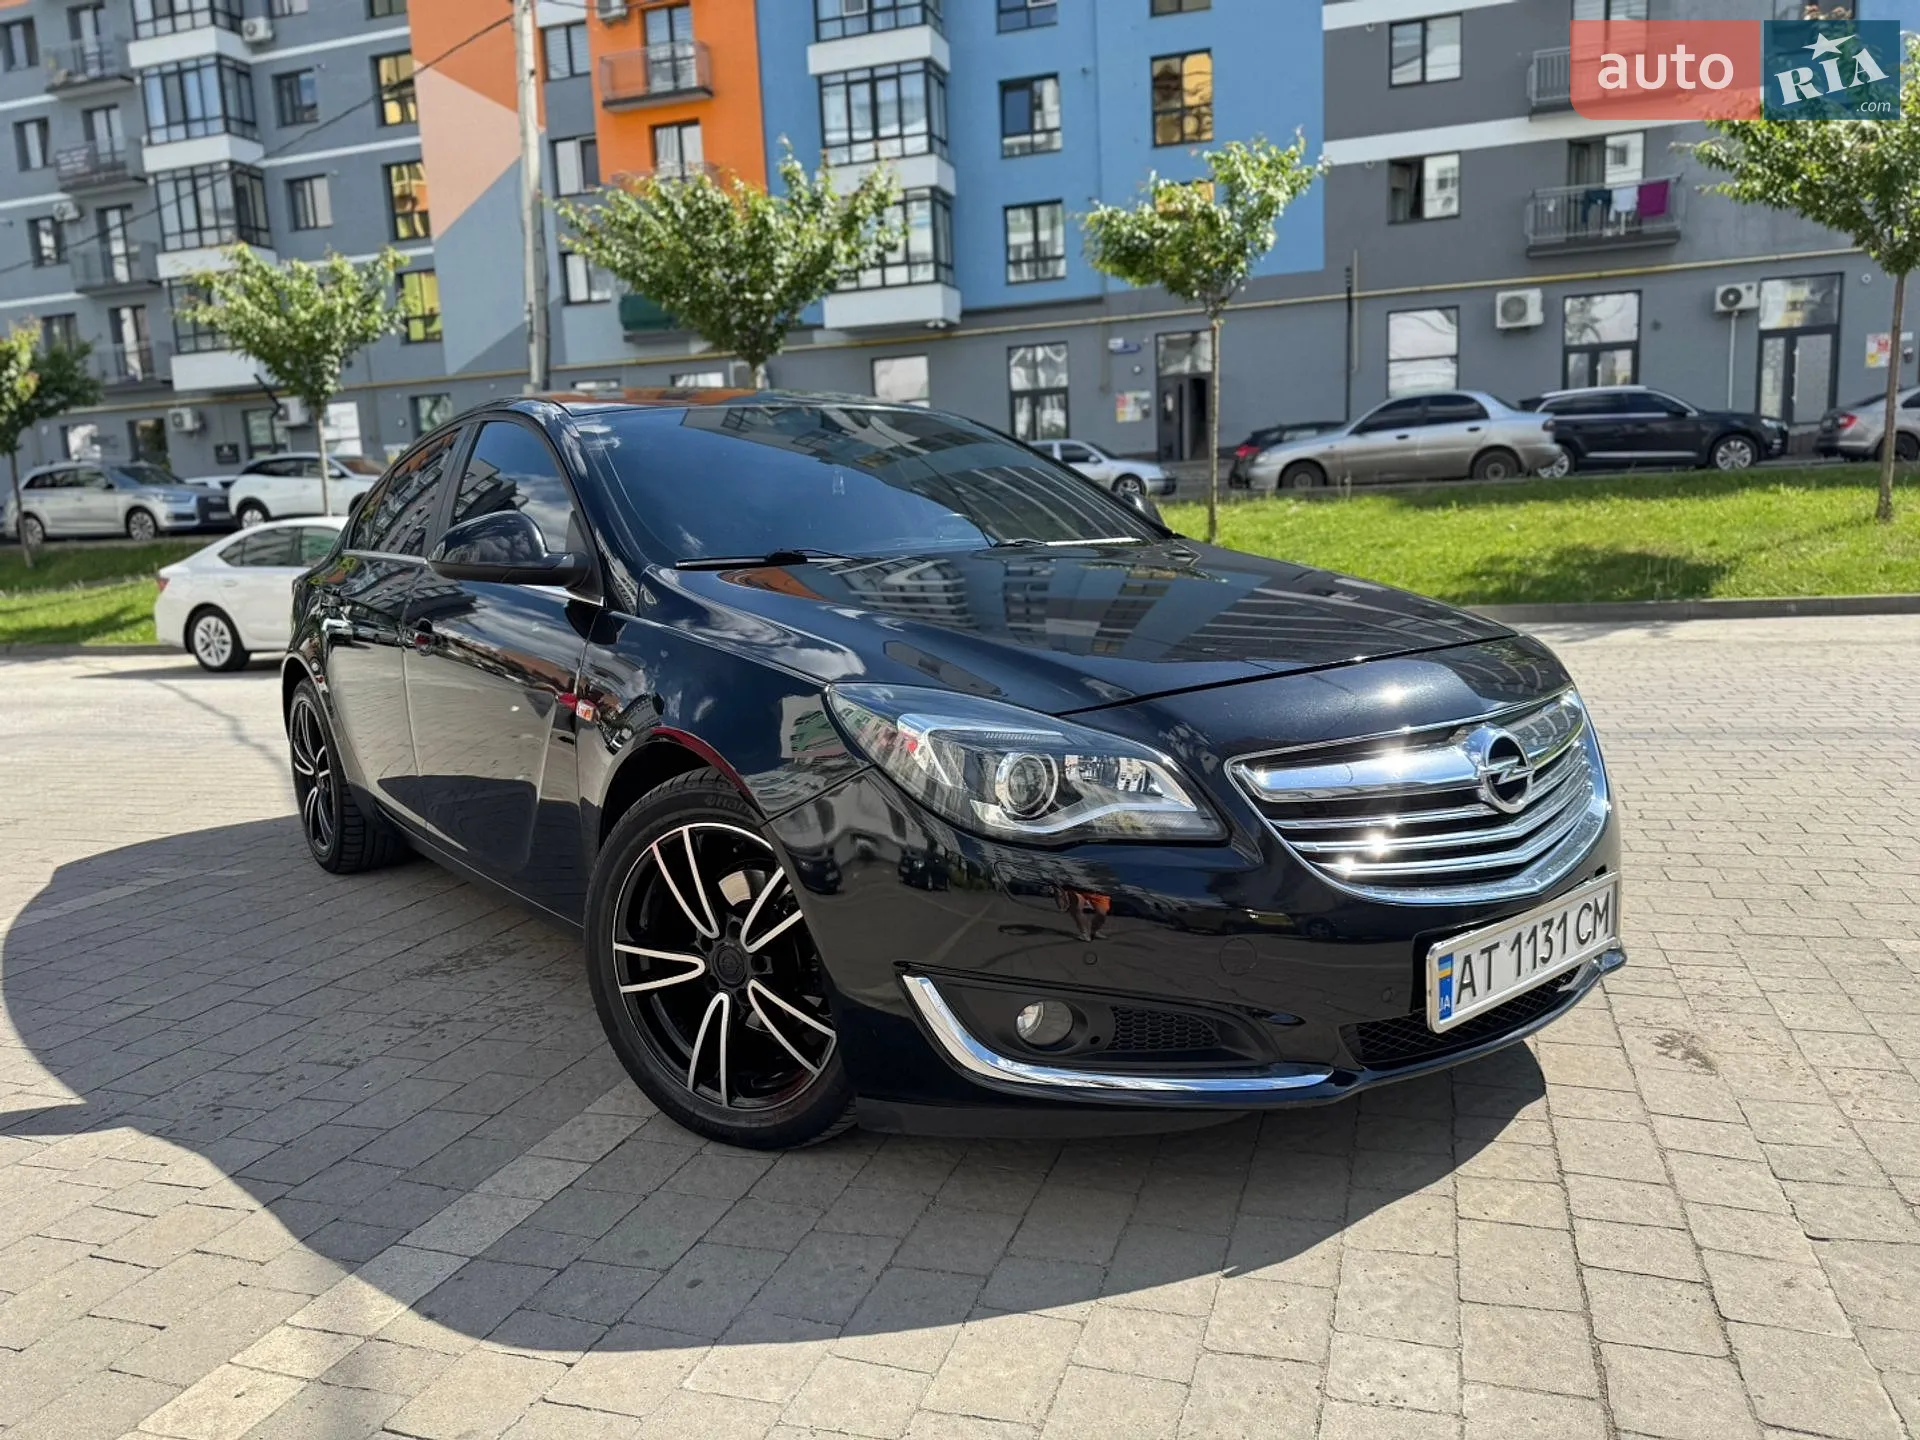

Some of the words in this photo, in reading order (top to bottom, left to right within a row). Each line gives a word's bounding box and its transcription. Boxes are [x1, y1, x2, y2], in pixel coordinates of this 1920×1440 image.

[1456, 942, 1500, 1004] AT
[1510, 911, 1568, 977] 1131
[1576, 891, 1610, 946] CM
